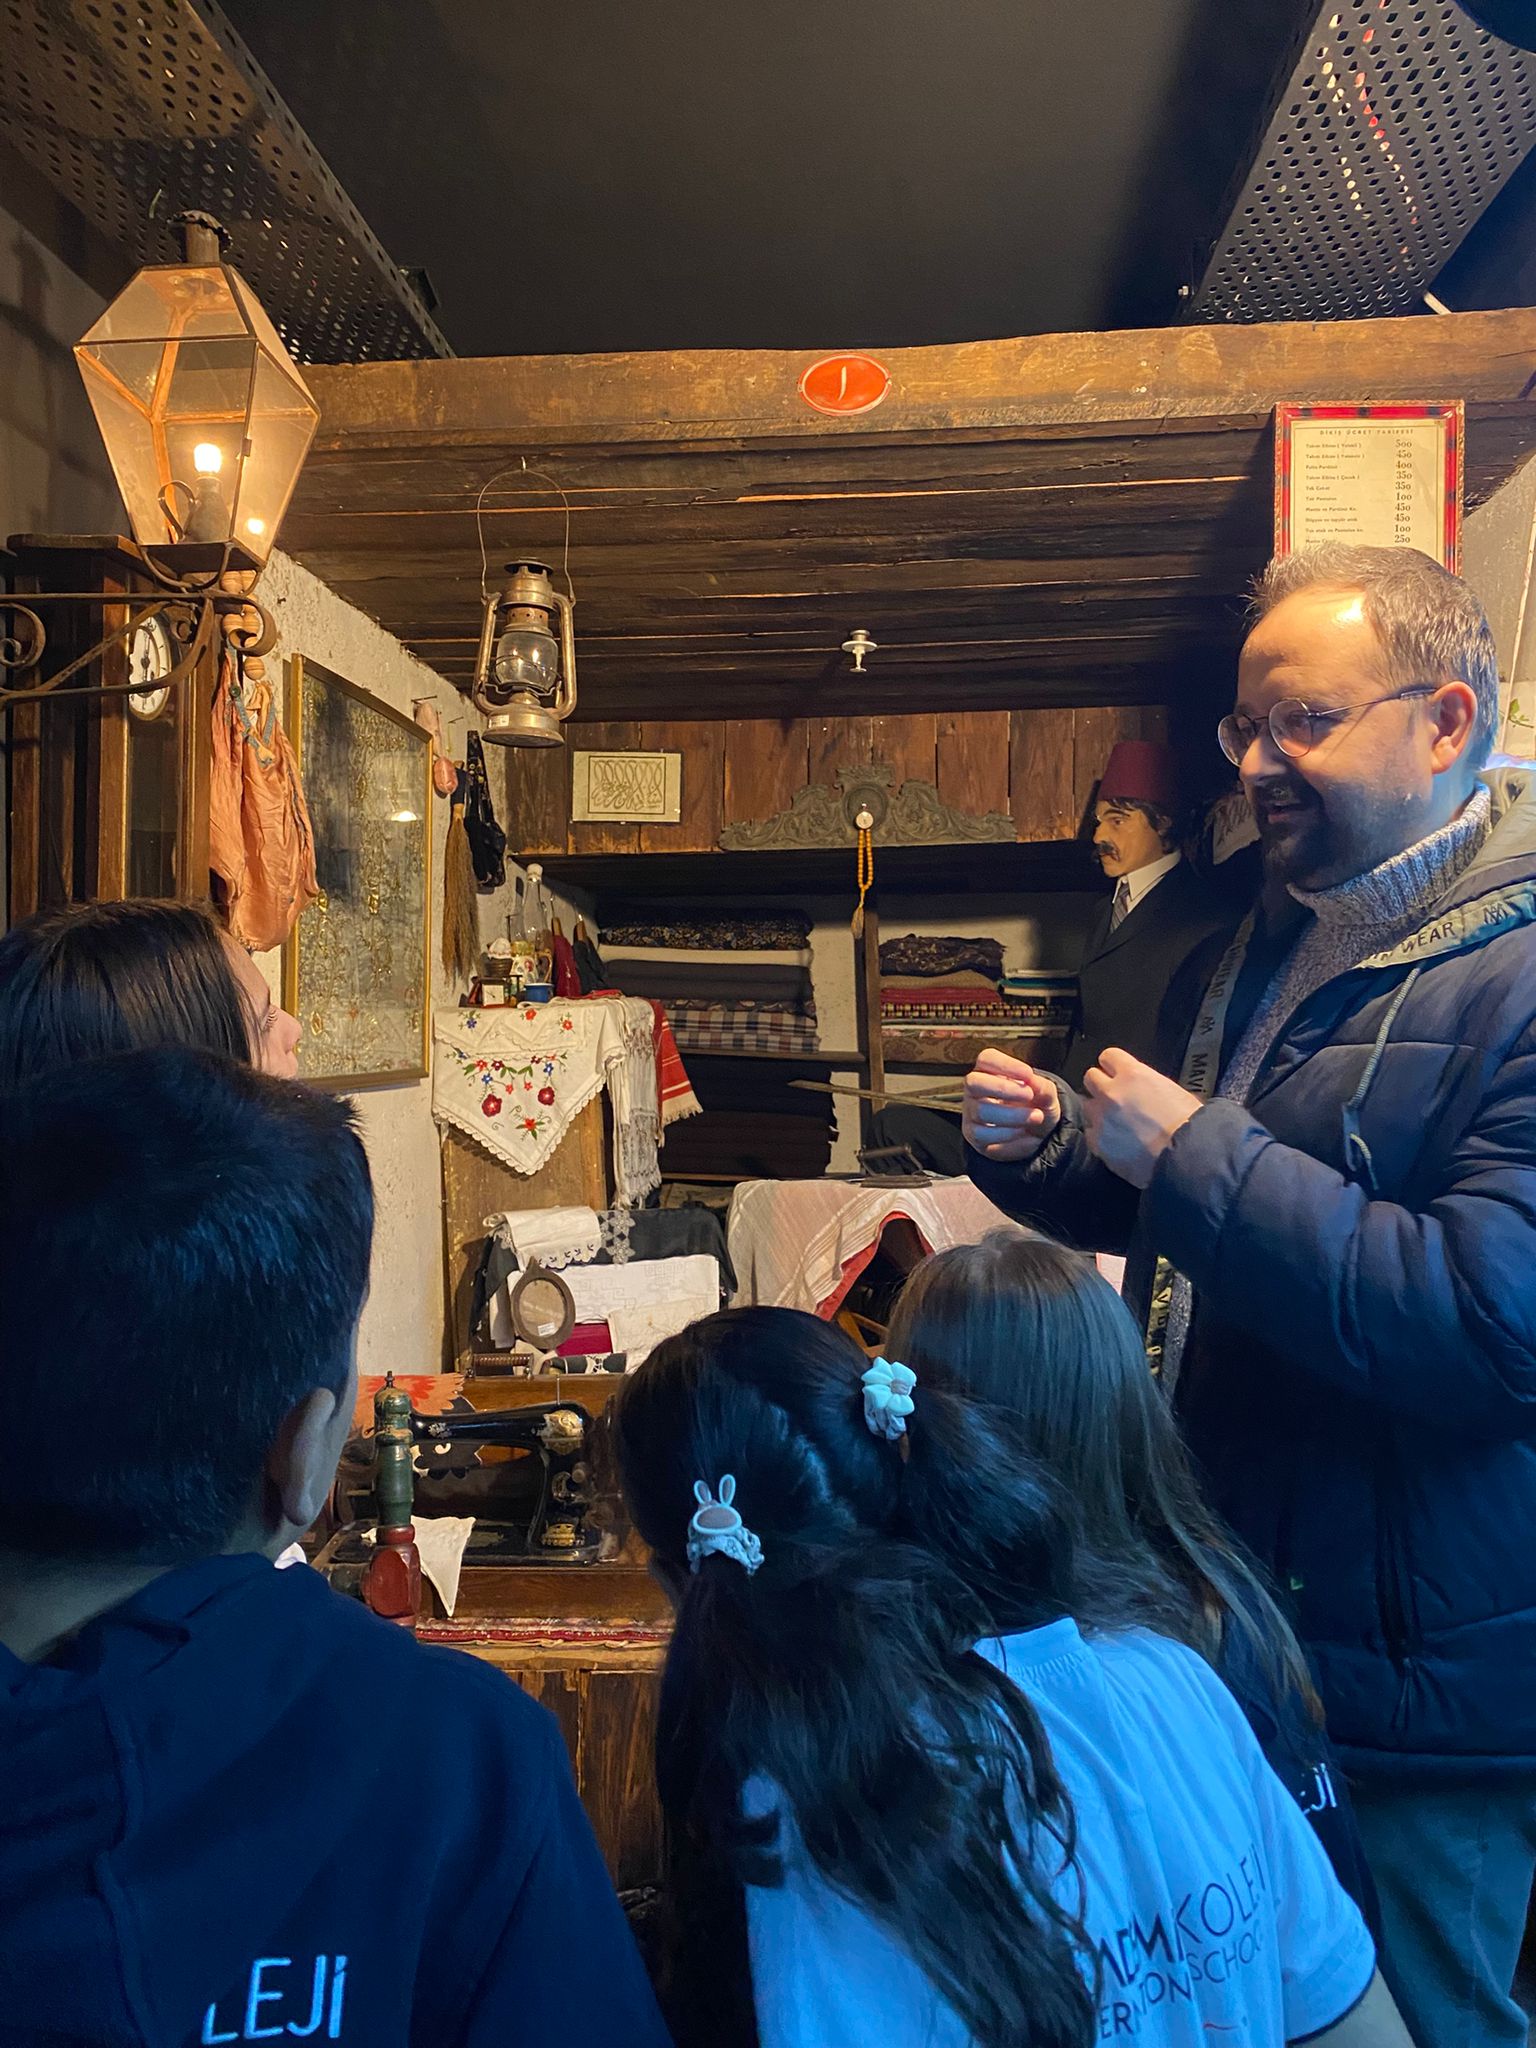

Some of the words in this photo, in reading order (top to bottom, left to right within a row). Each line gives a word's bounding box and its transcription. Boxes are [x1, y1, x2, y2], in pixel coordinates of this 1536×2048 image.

[1395, 438, 1412, 448] 500
[1396, 449, 1412, 458] 450
[1395, 460, 1412, 469] 400
[1396, 470, 1413, 480] 350
[1395, 480, 1411, 490] 350
[1396, 492, 1412, 501] 100
[1395, 502, 1411, 511] 450
[1394, 513, 1411, 522] 450
[1394, 524, 1411, 533] 100
[1394, 534, 1411, 543] 250
[1401, 921, 1455, 953] WEAR
